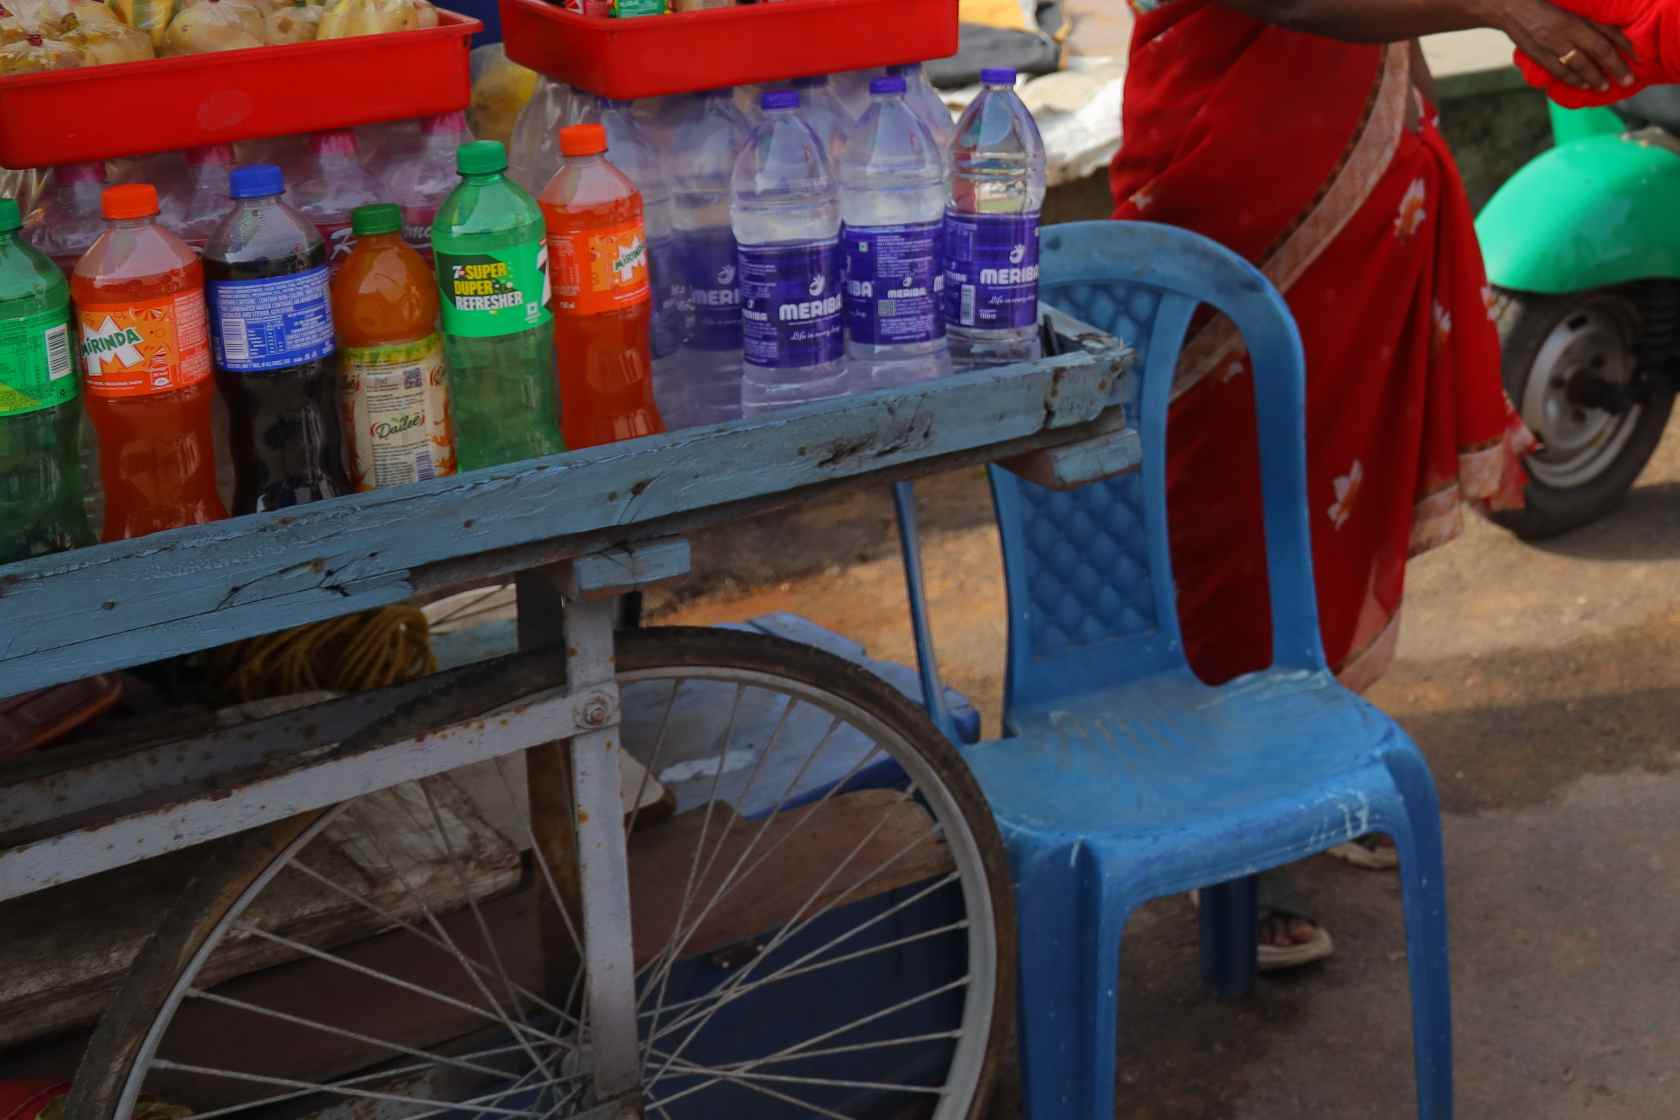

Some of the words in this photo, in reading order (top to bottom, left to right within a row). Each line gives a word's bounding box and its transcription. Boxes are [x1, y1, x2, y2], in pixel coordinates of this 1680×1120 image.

[464, 262, 507, 280] SUPER
[453, 280, 494, 296] DUPER
[455, 291, 523, 311] REFRESHER
